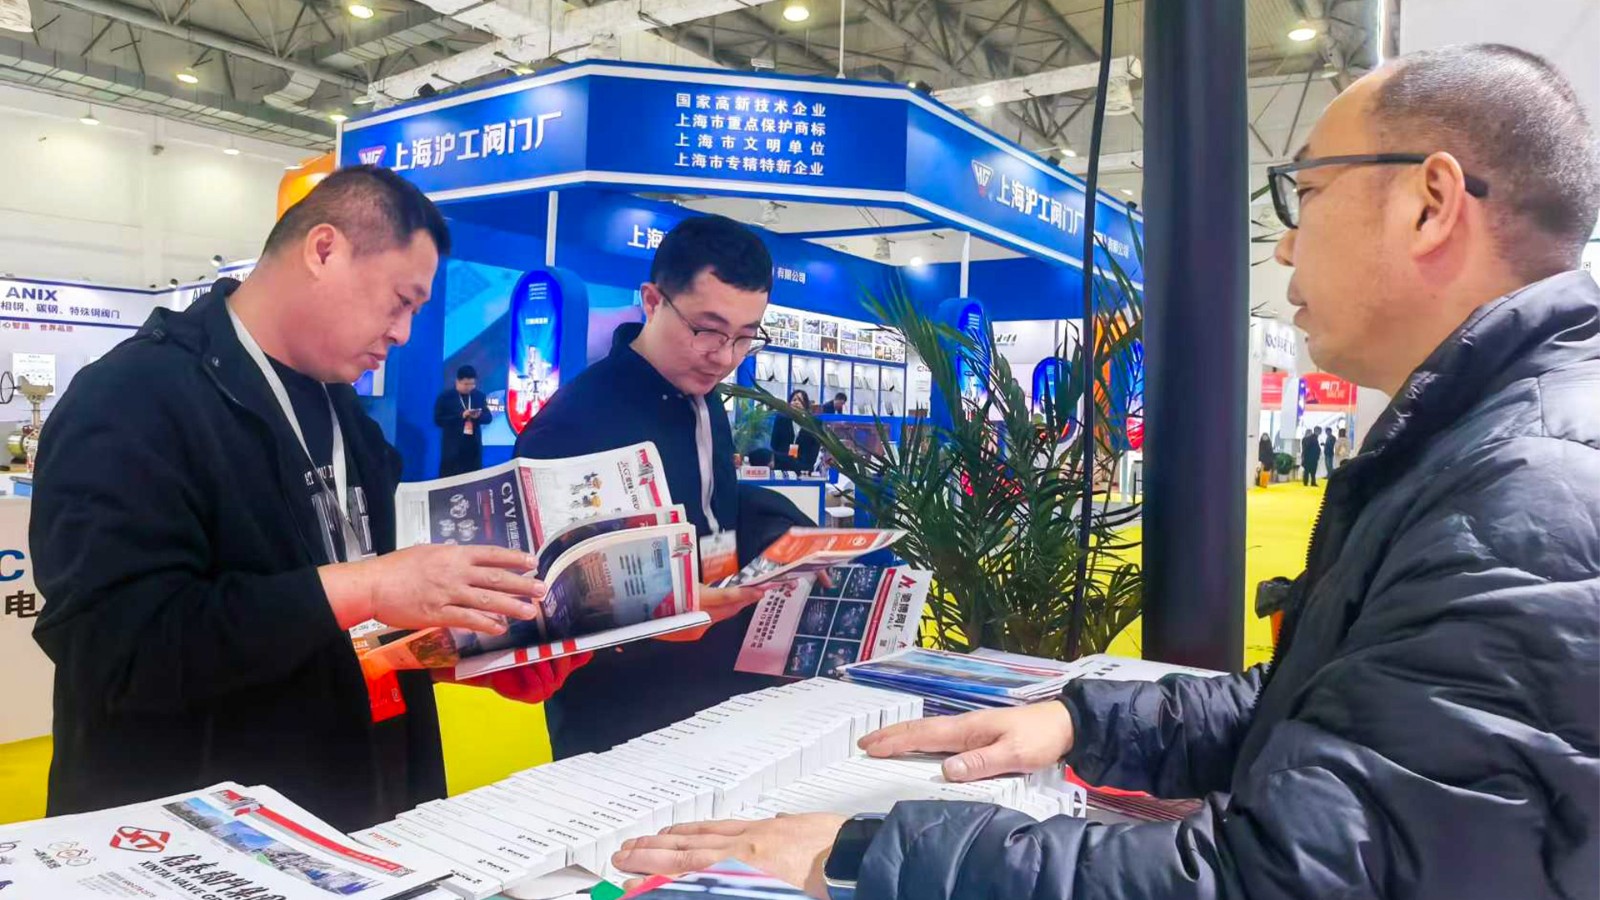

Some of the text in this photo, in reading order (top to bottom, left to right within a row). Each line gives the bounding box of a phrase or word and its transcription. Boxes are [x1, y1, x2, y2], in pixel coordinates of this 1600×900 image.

[676, 92, 826, 117] 国家高新技术企业
[675, 112, 826, 136] 上海市重点保护商标
[390, 111, 562, 171] 上海沪工阀门厂
[675, 132, 825, 156] 上海市文明单位
[674, 152, 824, 176] 上海市专精特新企业
[996, 174, 1084, 236] 上海沪工阀门厂
[627, 224, 668, 250] 上海
[6, 286, 58, 301] ANIX
[501, 481, 516, 519] CYV
[5, 590, 40, 619] 电
[138, 860, 175, 878] XINTAI
[172, 876, 206, 895] VALVE
